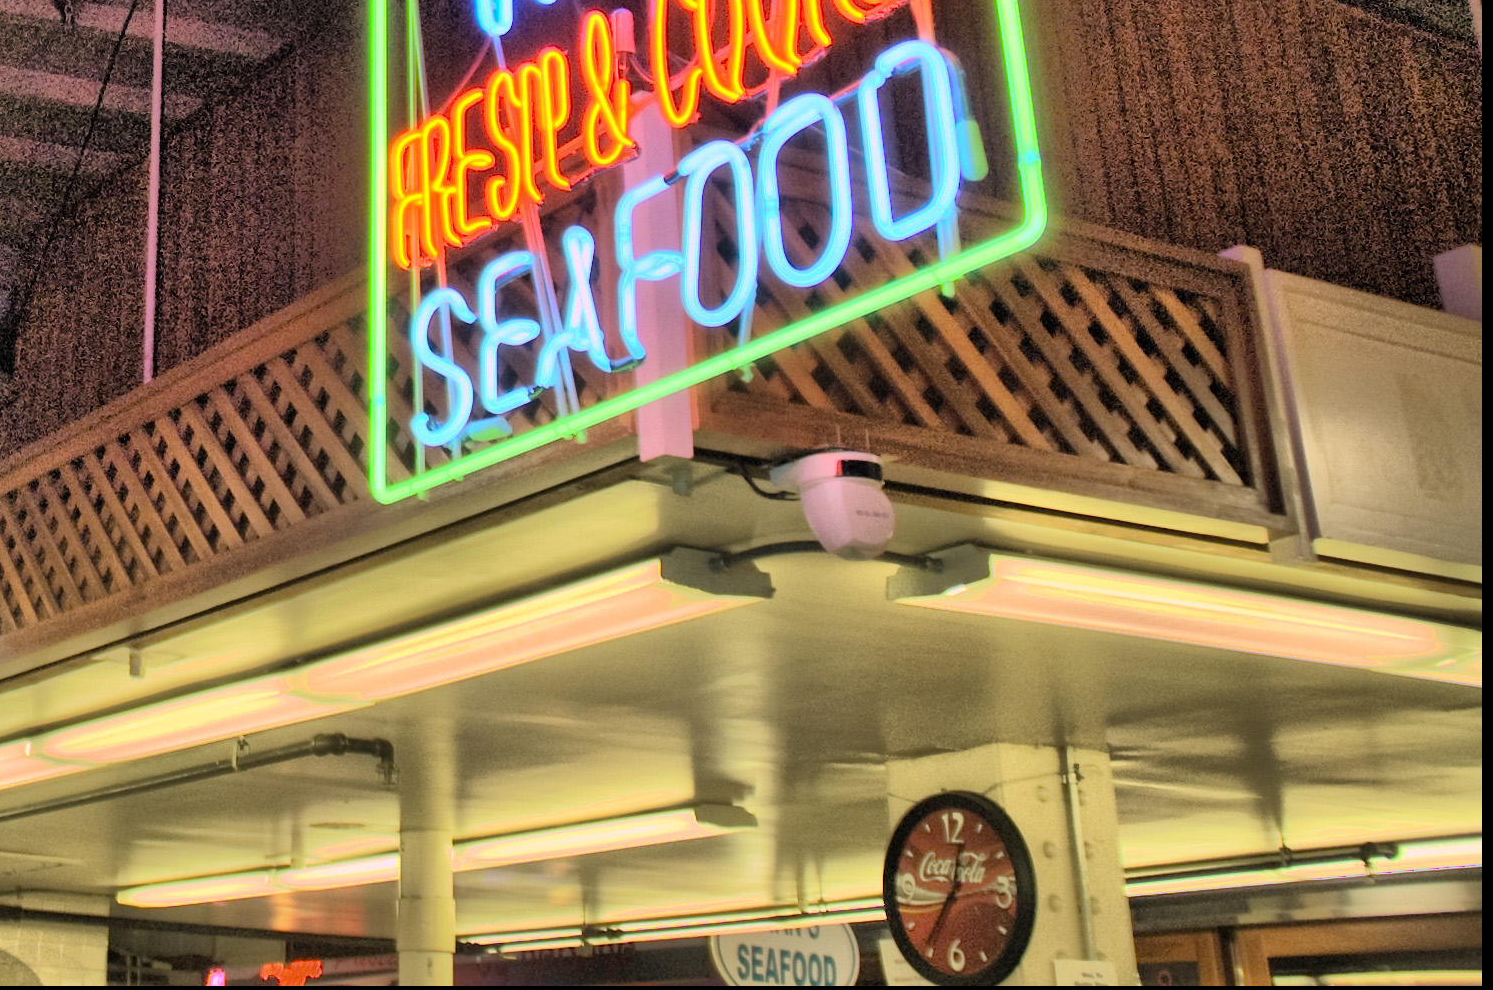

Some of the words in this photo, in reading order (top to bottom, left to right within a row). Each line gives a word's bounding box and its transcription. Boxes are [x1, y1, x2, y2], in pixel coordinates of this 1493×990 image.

[392, 46, 572, 270] FRESH
[580, 10, 634, 167] &
[410, 39, 961, 448] SEAFOOD
[941, 811, 966, 845] 12
[919, 851, 988, 884] CocaCola
[905, 873, 917, 902] 9
[995, 876, 1013, 909] 3
[737, 943, 838, 986] SEAFOOD
[947, 937, 966, 973] 6
